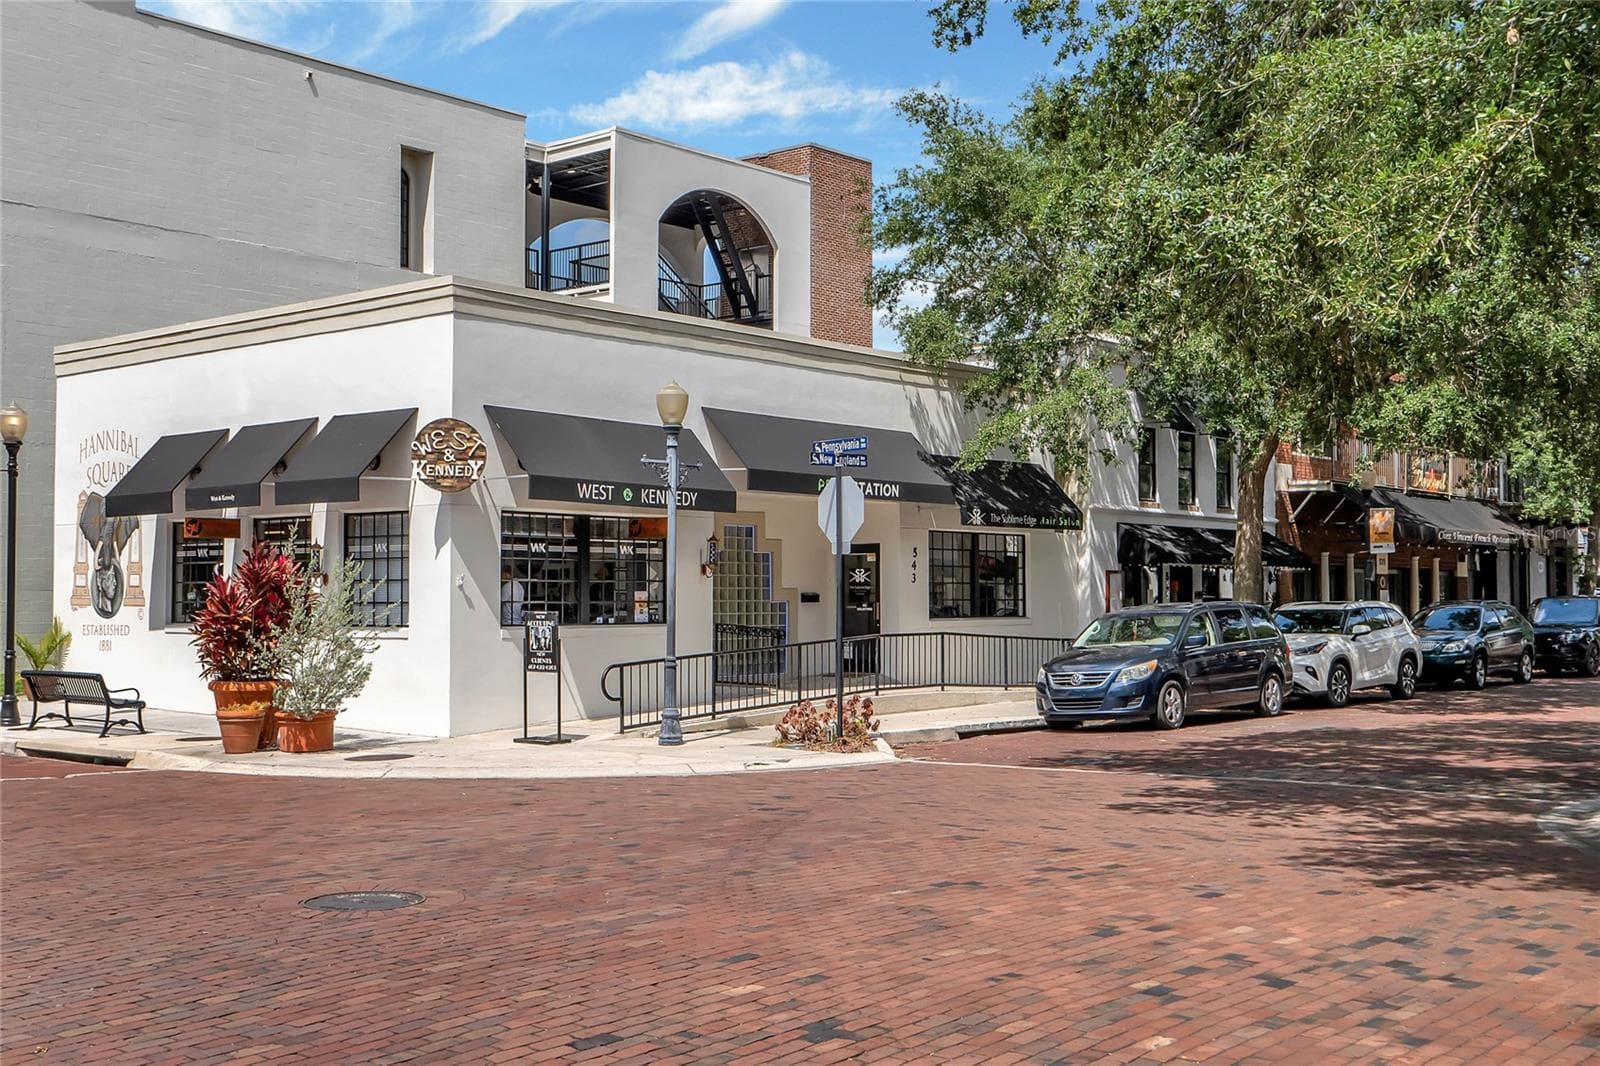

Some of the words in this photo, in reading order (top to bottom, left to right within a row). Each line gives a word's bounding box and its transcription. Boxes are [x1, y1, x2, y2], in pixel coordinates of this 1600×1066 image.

[80, 429, 139, 463] HANNIBAL
[411, 429, 487, 456] WEST
[821, 439, 860, 453] Pennsylvania
[444, 449, 455, 461] &
[820, 454, 833, 464] New
[835, 455, 860, 467] England
[411, 460, 484, 479] KENNEDY
[577, 483, 614, 500] WEST
[641, 488, 697, 506] KENEDY
[856, 481, 900, 497] TATION
[990, 513, 1001, 521] The
[1002, 514, 1023, 524] Sublime
[1024, 515, 1037, 526] Edge
[82, 624, 130, 636] ESTABLISHED
[99, 640, 112, 651] 1881
